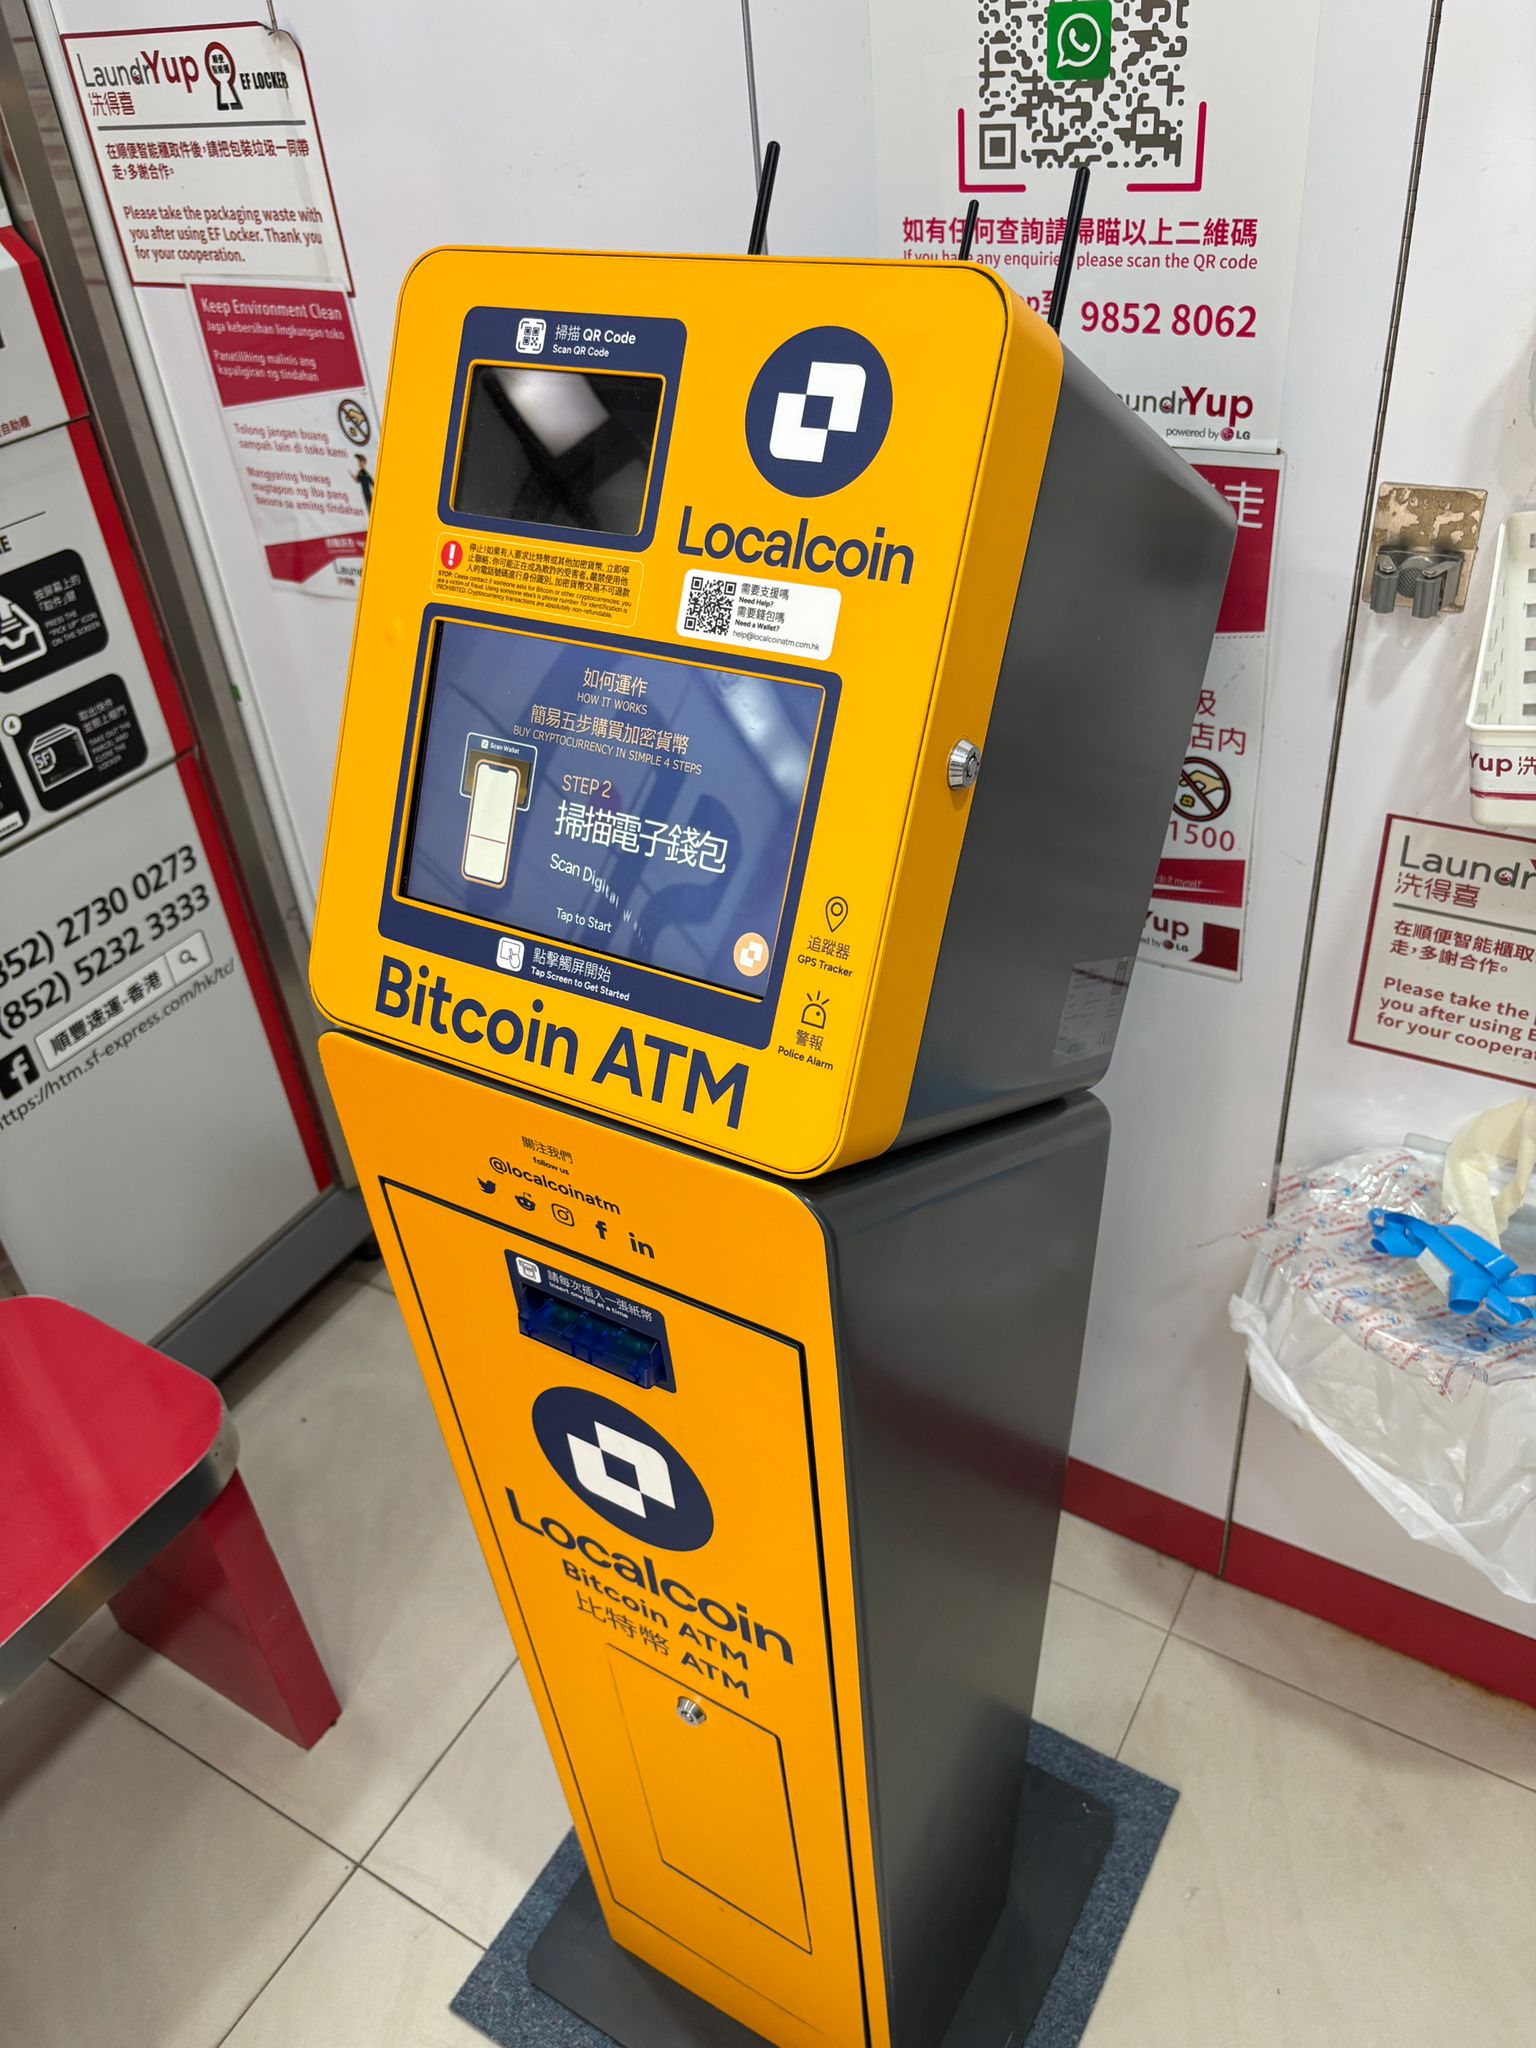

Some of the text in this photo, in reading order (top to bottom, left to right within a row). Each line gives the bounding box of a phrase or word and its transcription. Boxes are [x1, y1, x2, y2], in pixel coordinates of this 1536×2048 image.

[77, 50, 199, 94] LaundrYup
[239, 71, 289, 90] EF LOCKER
[88, 91, 136, 117] 洗得喜
[123, 205, 323, 225] Please take the packaging waste with
[128, 225, 323, 246] you after using EF Locker. Thank you
[134, 245, 246, 265] for your cooperation.
[942, 249, 973, 261] hae
[976, 253, 1000, 269] any
[1003, 250, 1061, 270] enquirie
[1076, 250, 1123, 270] please
[1126, 254, 1162, 269] scan
[1164, 253, 1189, 269] the
[1193, 253, 1216, 272] QR
[1218, 253, 1258, 270] code
[200, 297, 343, 320] Keep Environment Clean
[1080, 300, 1257, 338] 9852 8062
[554, 323, 637, 345] 掃描 QR Code
[552, 343, 610, 358] Scan QR Code
[1166, 427, 1251, 442] powered by LG
[677, 505, 914, 585] Localcoin
[454, 572, 469, 580] Cease
[469, 575, 488, 584] contact
[493, 579, 515, 588] someone
[536, 585, 554, 595] Bitcoin
[561, 589, 575, 598] other
[739, 582, 790, 601] 需要支援嗎
[736, 605, 786, 625] 需要錢包嗎
[738, 595, 775, 608] Need Help?
[732, 629, 820, 651] help@localcoinatm.com.hk
[734, 618, 751, 629] Need
[757, 620, 781, 633] Wallet?
[582, 666, 649, 698] 如何運作
[576, 691, 648, 716] HOW IT WORKS
[530, 702, 690, 756] 簡易五步購買加密貨幣
[490, 741, 520, 755] Scan Wallet
[512, 724, 703, 776] BUY CRYPTOCURRENCY IN SIMPLE 4 STEPS
[561, 774, 613, 799] STEP 2
[553, 799, 729, 875] 掃描電子錢包
[1399, 835, 1536, 892] Laundr
[549, 853, 620, 909] Scan Digital
[1174, 878, 1203, 889] myself
[1394, 871, 1481, 909] 洗得喜
[56, 886, 130, 948] 2730
[131, 844, 198, 901] 0273
[556, 906, 573, 925] Tap
[575, 912, 586, 926] to
[587, 915, 613, 934] Start
[73, 925, 146, 987] 5232
[145, 883, 211, 942] 3333
[532, 946, 613, 984] 點擊觸屏開始
[797, 954, 854, 978] GPS Tracker
[531, 966, 631, 1001] Tap Screen to Get Started
[1383, 976, 1530, 1020] Please take the
[50, 969, 164, 1056] 順豐速運-香港
[1379, 996, 1523, 1041] you after using
[375, 955, 750, 1130] Bitcoin ATM
[795, 1028, 825, 1052] 警報
[1376, 1011, 1536, 1062] for your coopera
[777, 1045, 834, 1071] Police Alarm
[521, 1135, 574, 1165] 關注我們
[532, 1156, 570, 1176] follow us
[489, 1156, 622, 1216] @localcoinatm
[548, 1281, 570, 1295] Insert
[570, 1291, 584, 1301] one
[584, 1296, 596, 1306] bill
[597, 1301, 605, 1309] at
[611, 1307, 629, 1319] time
[504, 1486, 794, 1666] Localcoin
[561, 1557, 750, 1671] Bitcoin ATM
[575, 1589, 751, 1700] 比特幣 ATM
